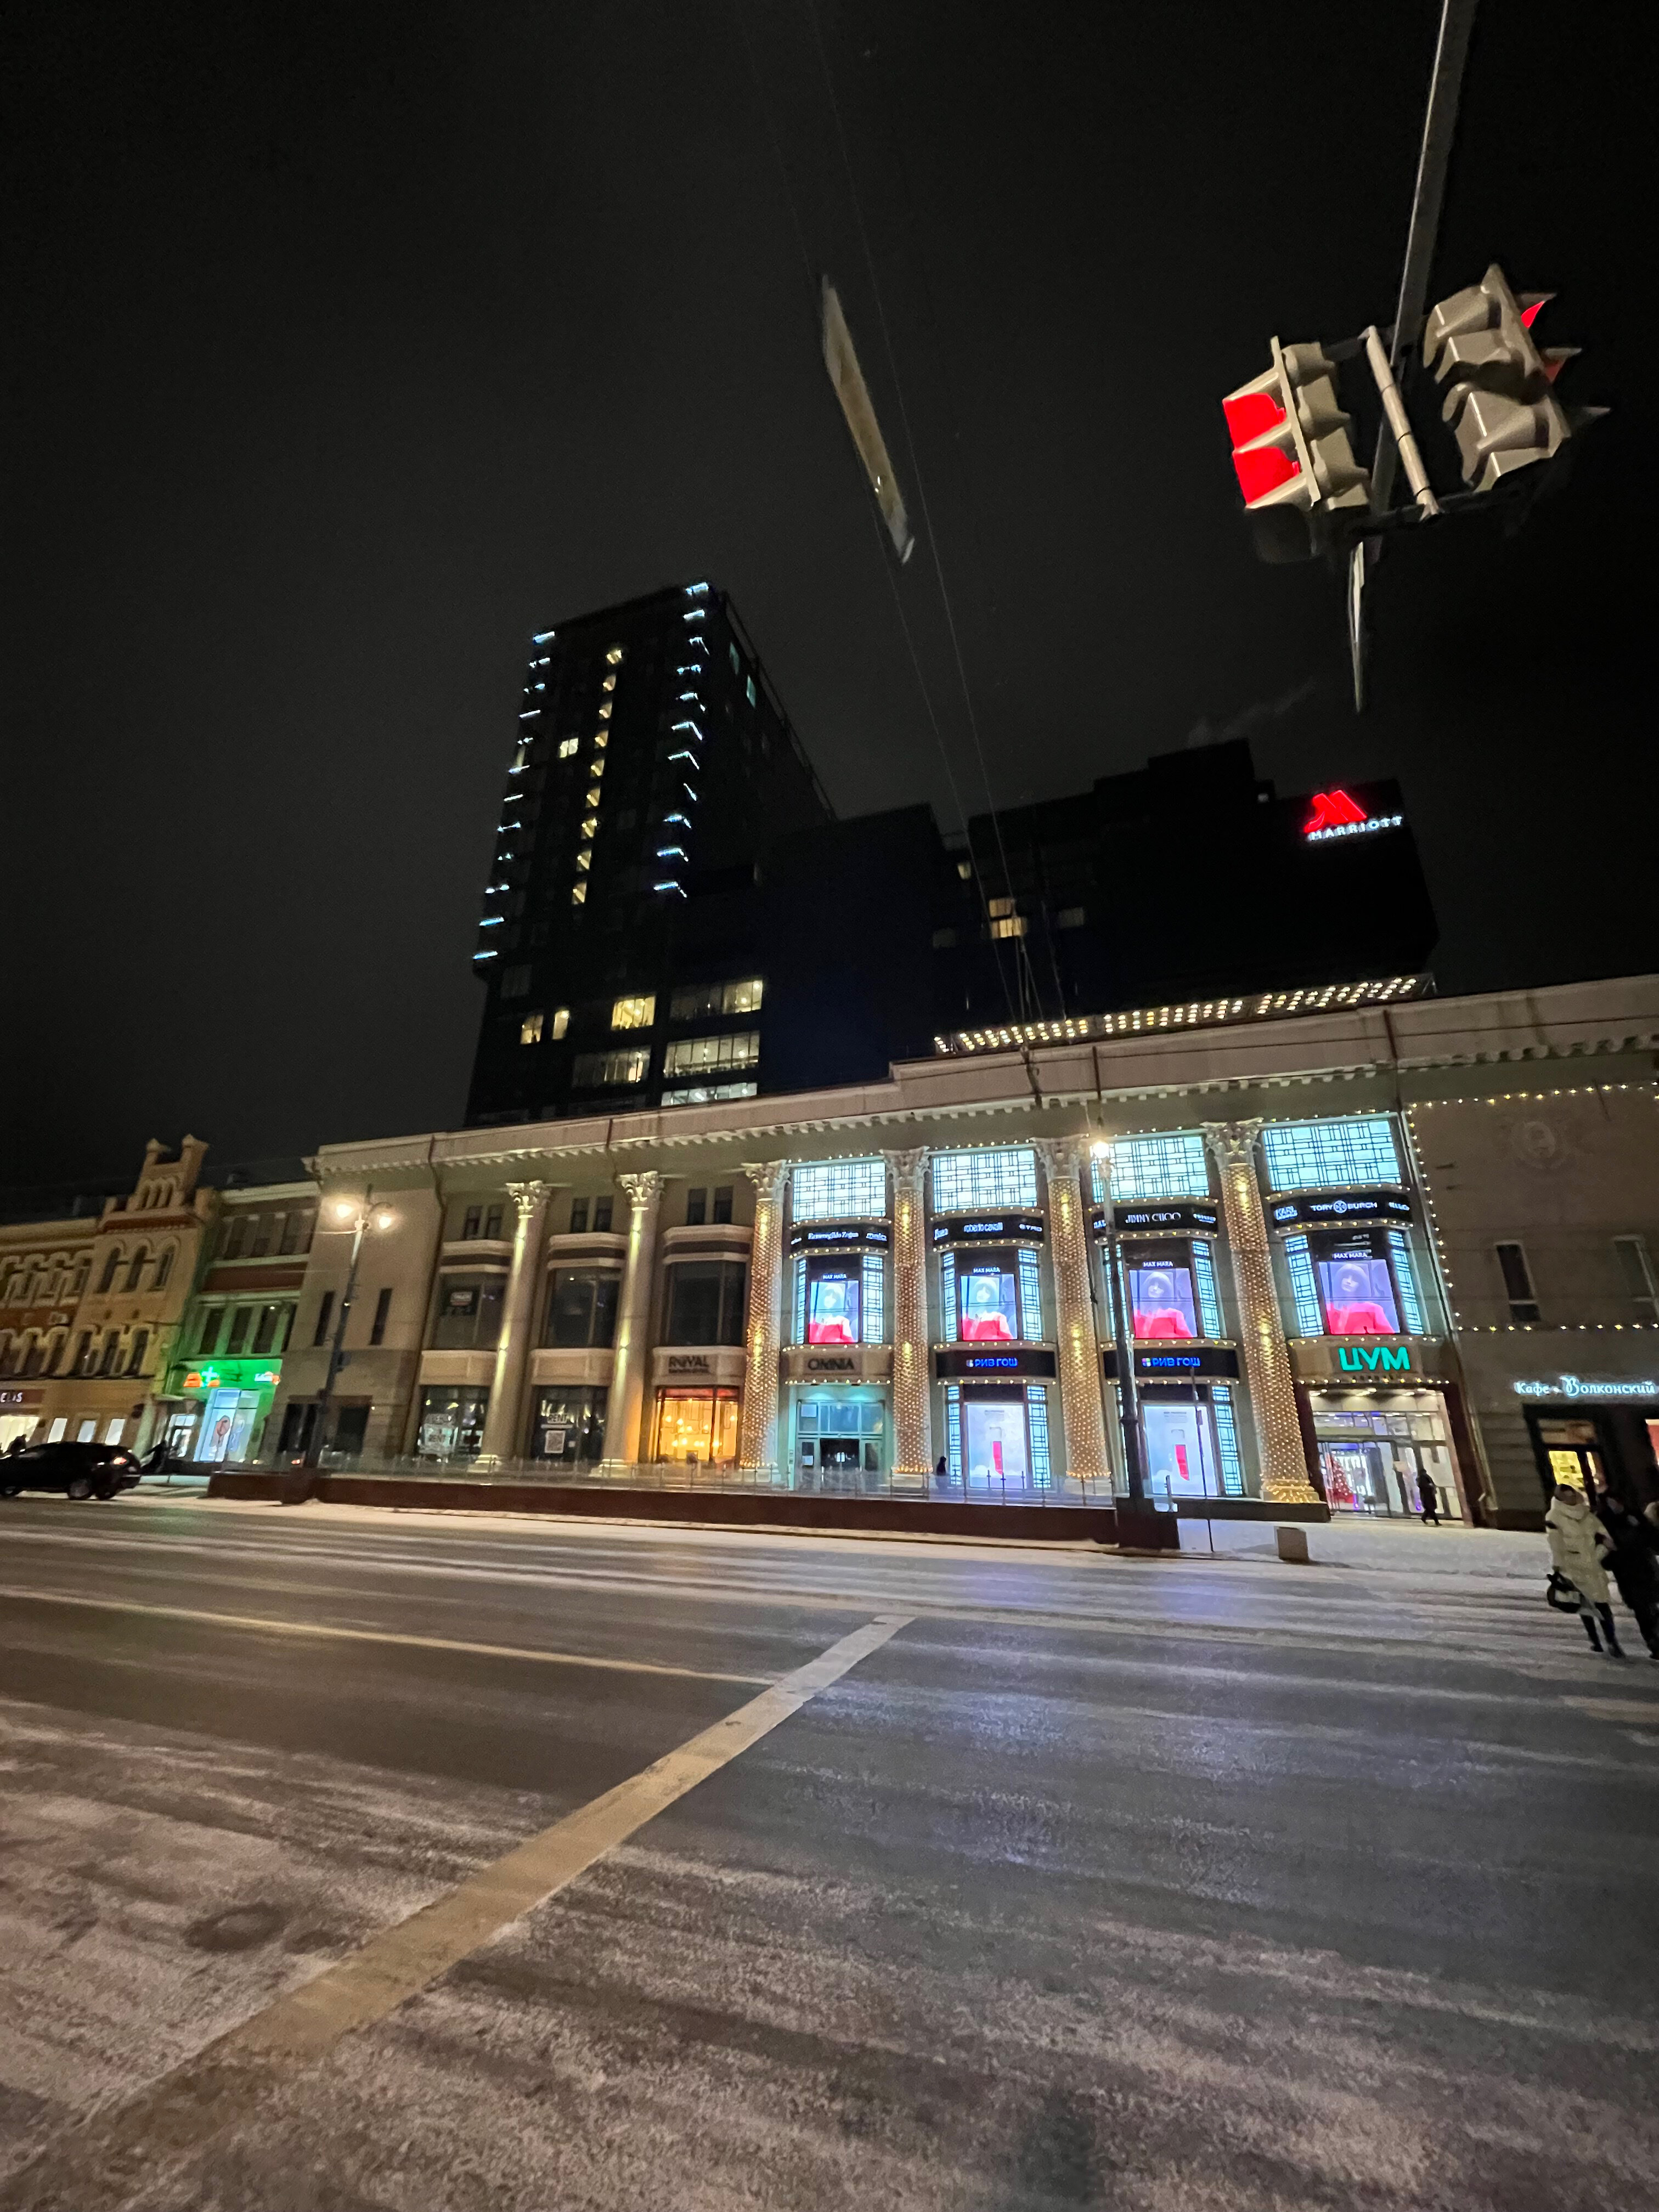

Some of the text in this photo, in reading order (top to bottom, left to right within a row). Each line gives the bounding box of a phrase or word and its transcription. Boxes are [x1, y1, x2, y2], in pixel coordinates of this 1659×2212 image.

[1309, 815, 1402, 840] MARRIOTT
[1152, 1212, 1181, 1221] CHOO
[975, 1357, 1018, 1367] РИВ ГОШ
[1152, 1357, 1200, 1367] РИВ ГОШ
[1339, 1346, 1410, 1371] ЦУМ
[1516, 1375, 1656, 1398] Кафе Волконский
